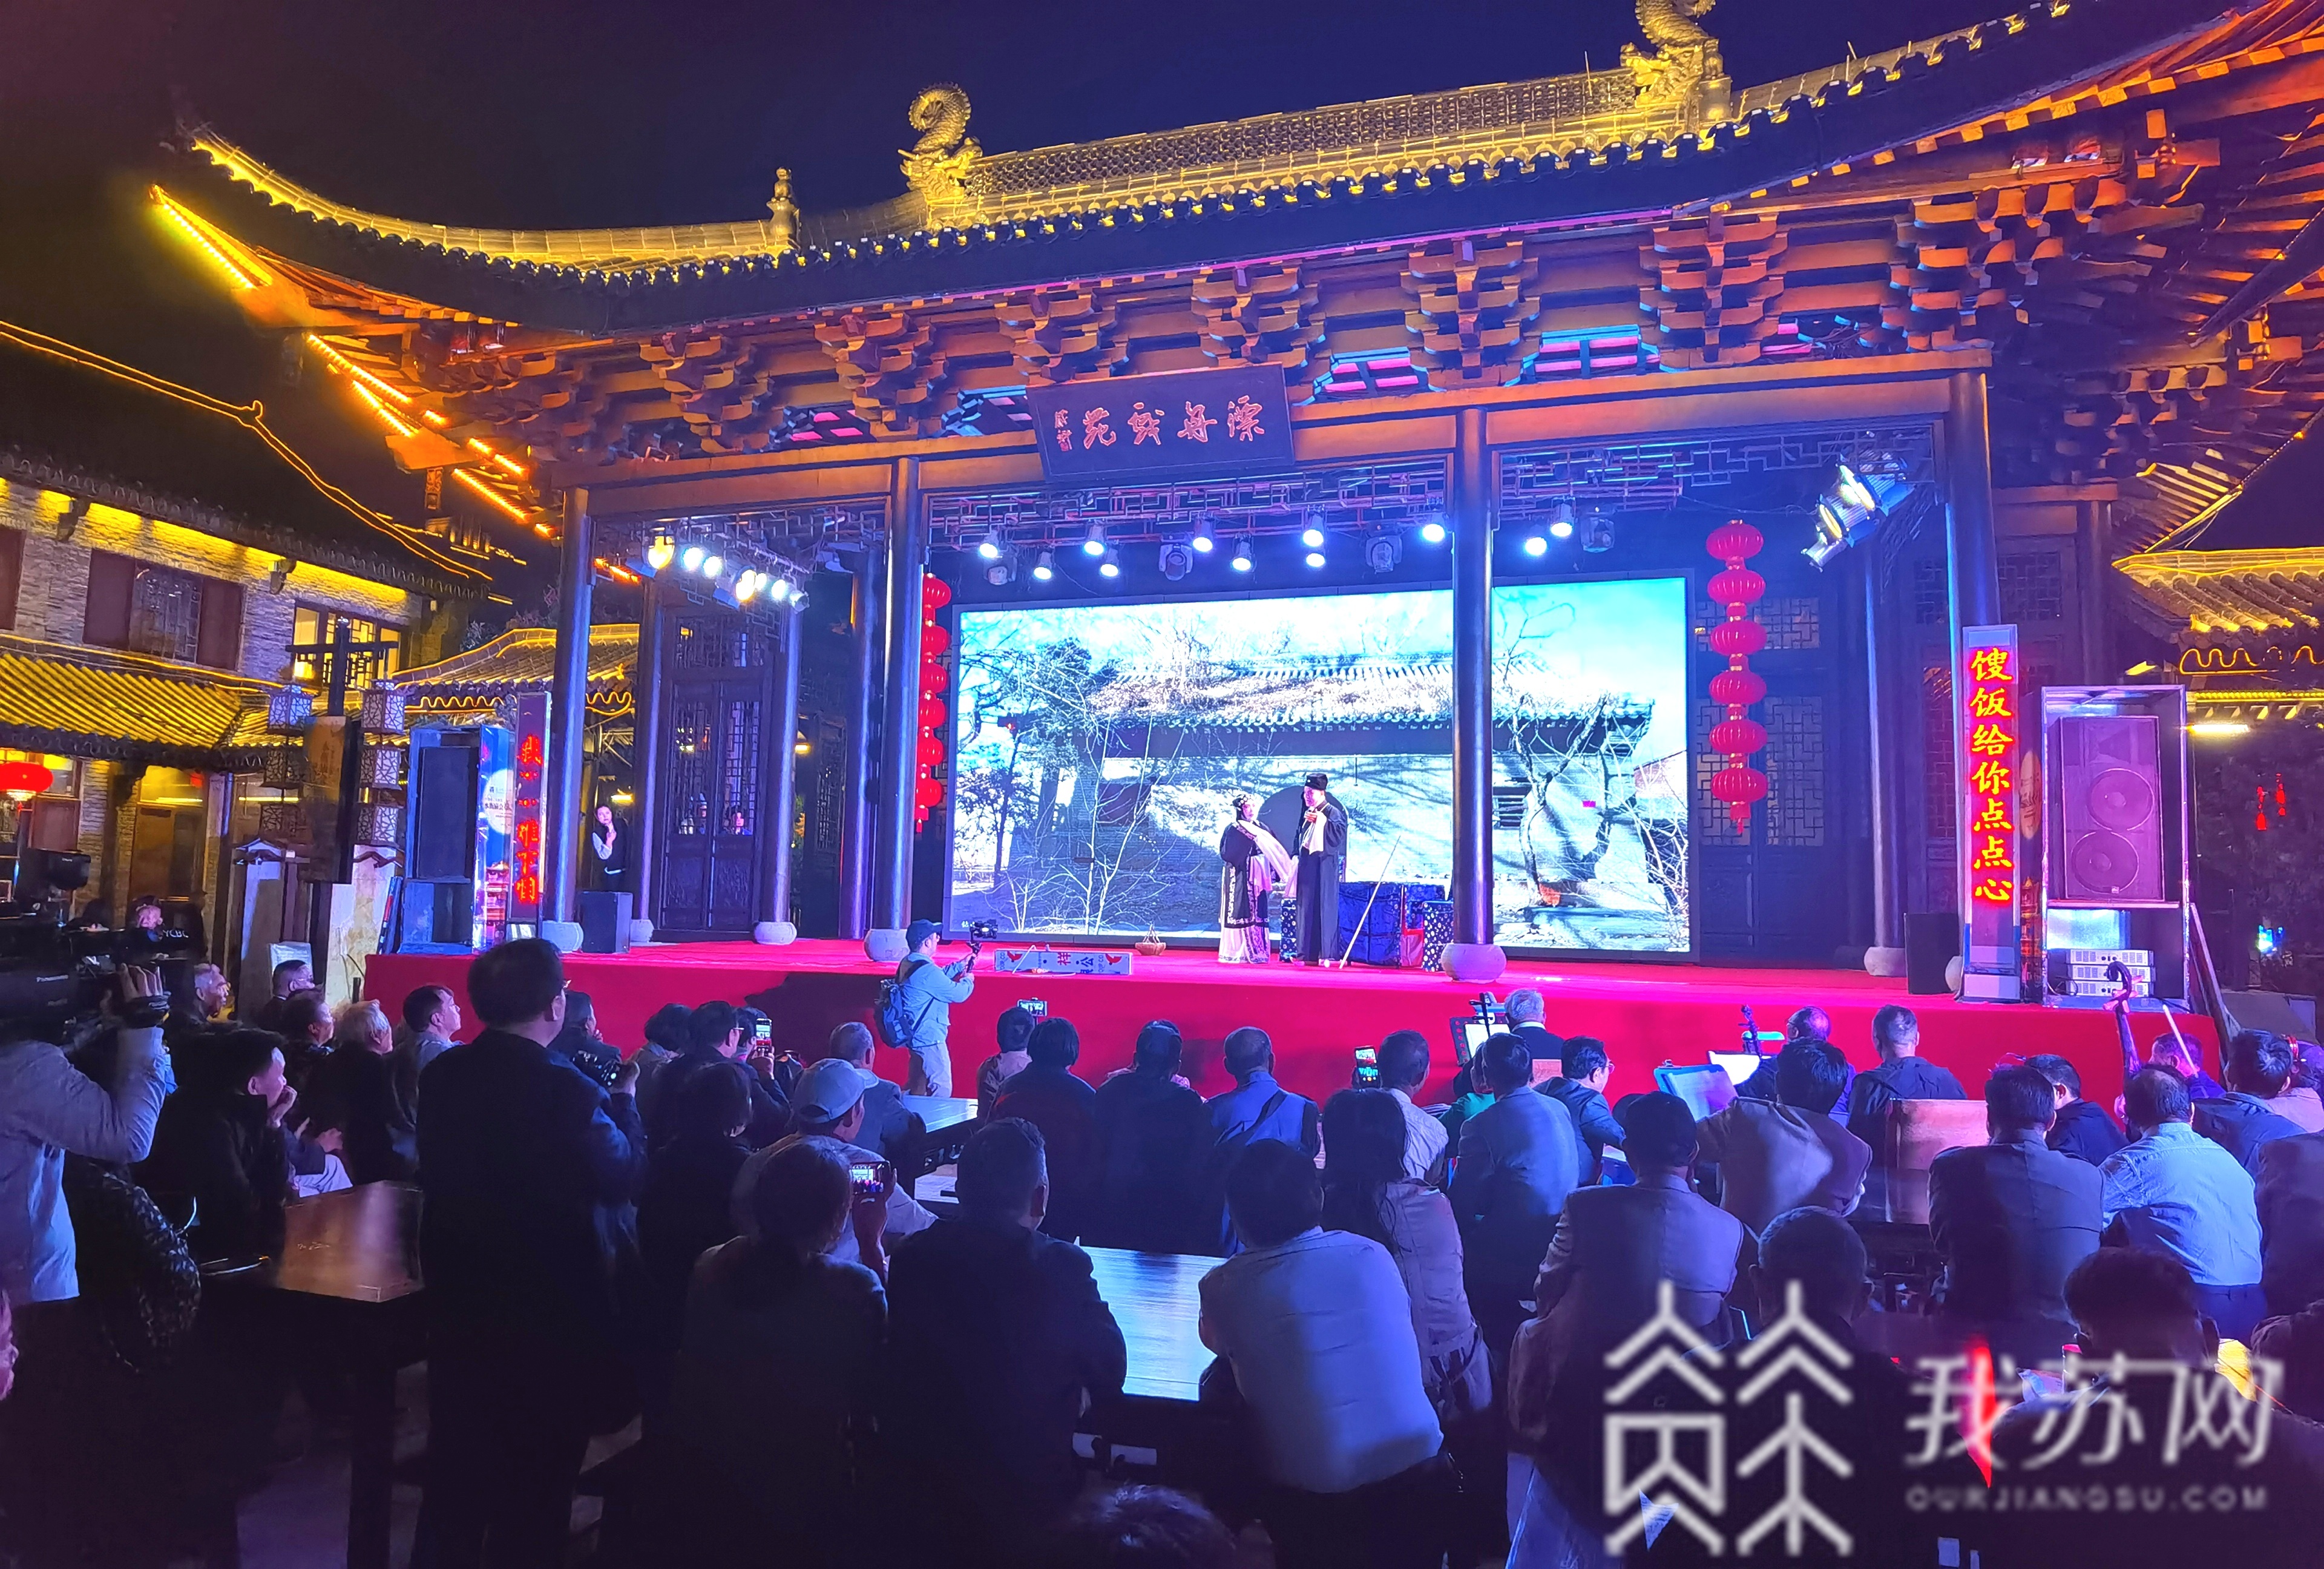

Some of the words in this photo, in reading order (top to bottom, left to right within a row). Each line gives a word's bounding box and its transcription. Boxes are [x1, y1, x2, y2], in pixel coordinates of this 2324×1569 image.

[1969, 647, 2013, 901] 馊饭给你点点心
